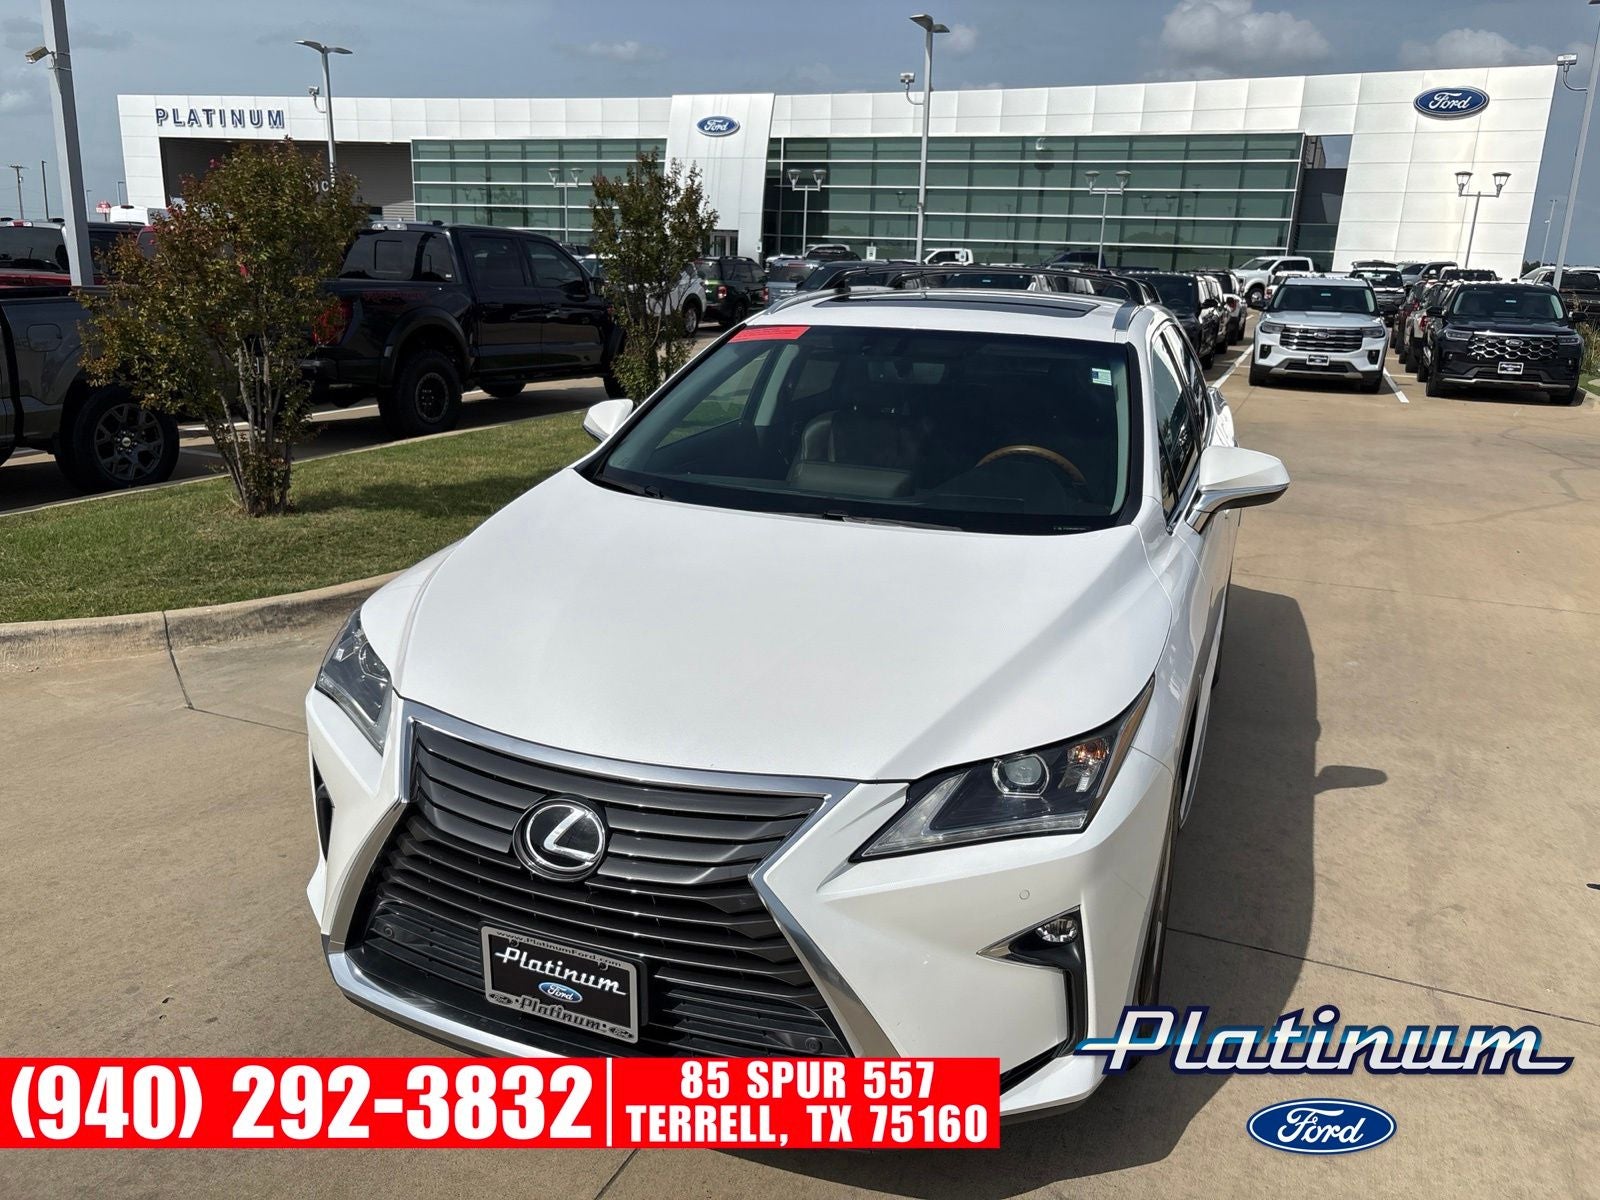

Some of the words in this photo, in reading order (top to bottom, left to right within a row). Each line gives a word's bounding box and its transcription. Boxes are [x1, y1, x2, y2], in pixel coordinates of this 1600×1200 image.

[1428, 91, 1473, 110] Ford
[155, 107, 285, 129] PLATINUM
[496, 931, 622, 967] www.PlatinumFord.com
[494, 946, 627, 996] Platinum
[546, 984, 574, 1001] Ford
[519, 997, 602, 1031] Platinum
